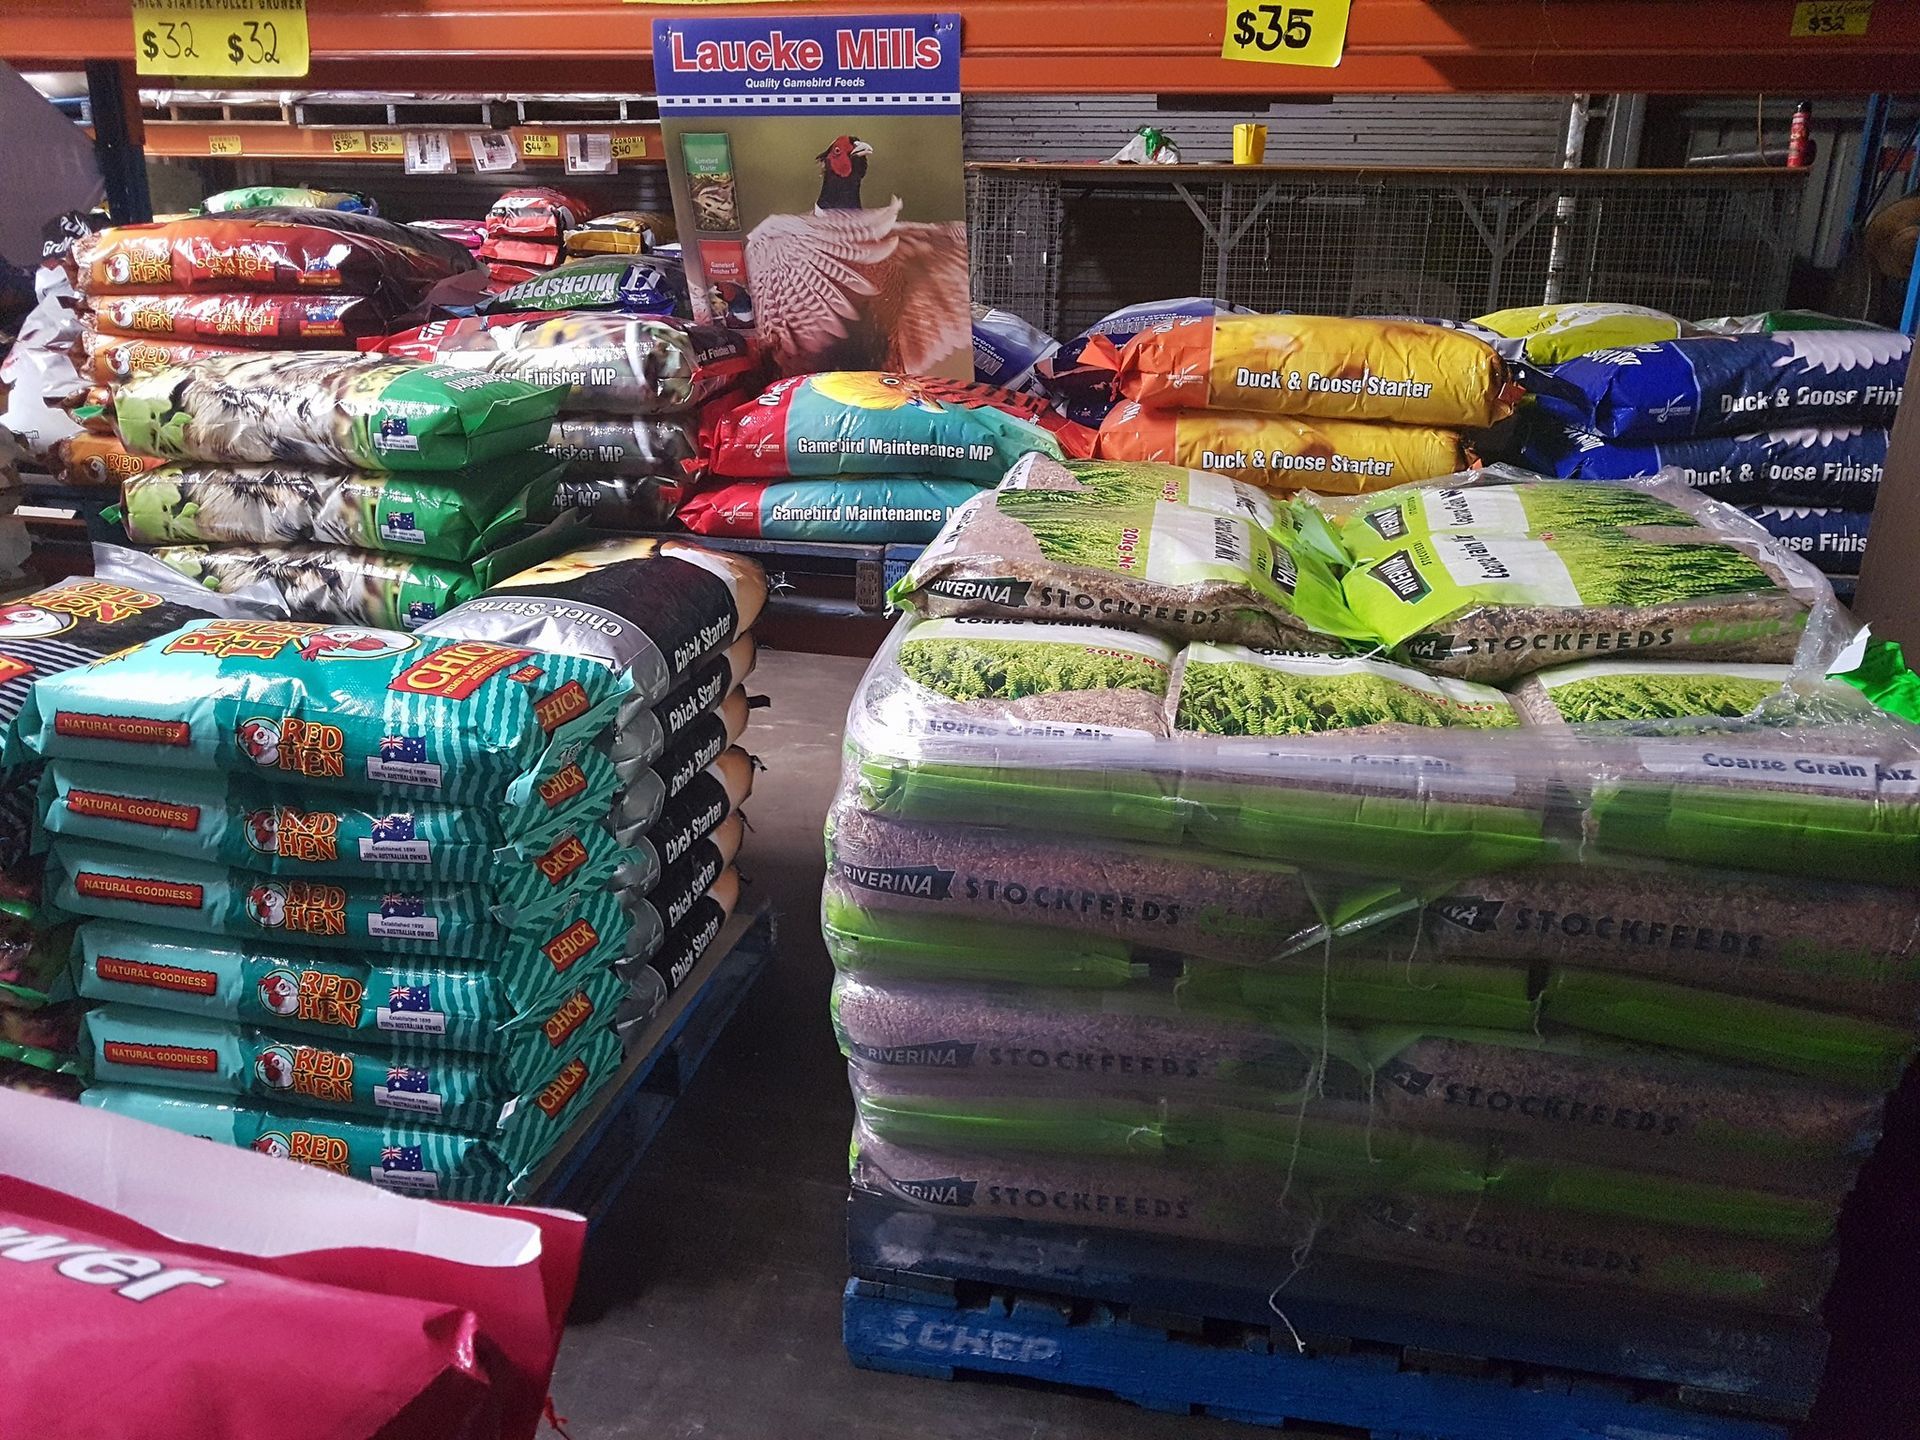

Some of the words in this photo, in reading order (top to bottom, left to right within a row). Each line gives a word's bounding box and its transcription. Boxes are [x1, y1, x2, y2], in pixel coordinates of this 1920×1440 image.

[142, 21, 199, 61] $32
[227, 21, 280, 65] $32
[1233, 4, 1314, 51] $35
[671, 30, 824, 73] Laucke
[836, 26, 943, 71] Mills
[745, 77, 781, 90] Quality
[783, 77, 832, 88] Gamebird
[834, 76, 865, 88] Feeds
[590, 367, 617, 386] MP
[1236, 367, 1282, 390] Duck
[1287, 371, 1302, 391] &
[1307, 372, 1362, 396] Goose
[1367, 375, 1432, 400] Starter
[1720, 391, 1769, 414] Duck
[1774, 387, 1791, 409] &
[1796, 386, 1858, 407] Goose
[599, 445, 625, 462] MP
[797, 437, 865, 455] Gamebird
[868, 437, 965, 460] Maintenance
[968, 444, 994, 462] MP
[1202, 450, 1247, 472] Duck
[1251, 450, 1266, 470] &
[1270, 450, 1325, 473] Goose
[1330, 455, 1394, 478] Starter
[1684, 466, 1732, 487] Duck
[1739, 463, 1754, 482] &
[1822, 463, 1884, 483] Finish
[771, 504, 841, 523] Gamebird
[845, 505, 941, 522] Maintenance
[1118, 527, 1139, 553] 20kg
[1378, 550, 1419, 596] RIVERINA
[550, 605, 624, 637] Chick
[1039, 587, 1222, 625] STOCKFEEDS
[674, 634, 702, 673] Chick
[699, 612, 732, 652] Starter
[1084, 647, 1135, 662] 20kg
[1466, 628, 1675, 656] STOCKFEEDS
[63, 717, 115, 733] NATURAL
[118, 721, 181, 739] GOODNESS
[669, 698, 698, 734] Chick
[280, 717, 344, 752] RED
[278, 744, 344, 777] HEN
[693, 735, 721, 774] Starter
[1701, 752, 1787, 772] Coarse
[1794, 759, 1868, 778] Grain
[539, 766, 585, 802] CHICK
[127, 803, 189, 823] GOODNESS
[278, 806, 338, 837] RED
[276, 831, 338, 861] HEN
[665, 828, 692, 865] Chick
[690, 800, 722, 840] Starter
[83, 877, 133, 894] NATURAL
[134, 883, 193, 901] GOODNESS
[285, 881, 346, 912] RED
[667, 889, 693, 928] Chick
[690, 859, 716, 901] Starter
[843, 865, 933, 896] RIVERINA
[964, 880, 1183, 926] STOCKFEEDS
[284, 904, 346, 936] HEN
[416, 930, 435, 938] OWNED
[1514, 907, 1766, 956] STOCKFEEDS
[548, 923, 597, 965] CHICK
[670, 949, 694, 988] Chick
[692, 916, 719, 955] Starter
[103, 962, 151, 979] NATURAL
[152, 969, 207, 987] GOODNESS
[298, 970, 363, 1002] RED
[297, 996, 362, 1029] HEN
[424, 1024, 442, 1032] OWNED
[545, 991, 591, 1040] CHICK
[111, 1046, 155, 1061] NATURAL
[156, 1050, 209, 1065] GOODNESS
[293, 1046, 354, 1080] RED
[867, 1046, 958, 1067] RIVERINA
[988, 1047, 1201, 1078] STOCKFEEDS
[292, 1070, 353, 1102] HEN
[538, 1062, 586, 1110] CHICK
[1444, 1083, 1681, 1135] STOCKFEEDS
[290, 1131, 350, 1164] RED
[988, 1186, 1191, 1219] STOCKFEEDS
